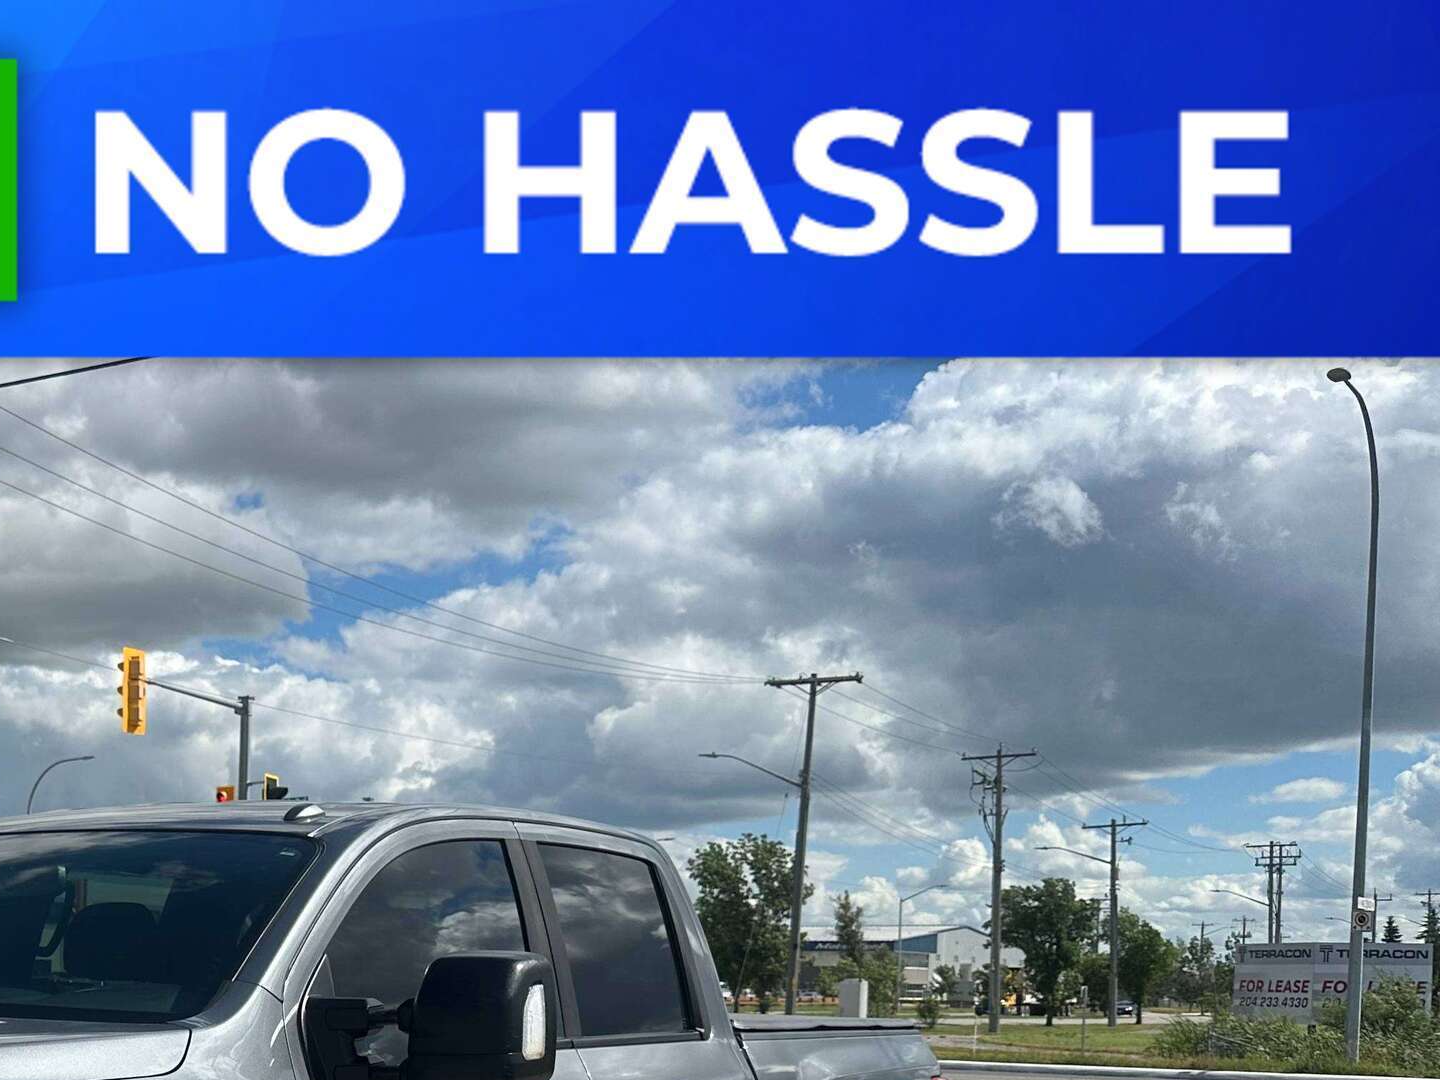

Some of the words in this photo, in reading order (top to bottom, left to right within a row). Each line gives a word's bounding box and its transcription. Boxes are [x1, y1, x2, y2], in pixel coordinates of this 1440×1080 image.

[1248, 949, 1312, 959] TERRACON
[1239, 979, 1264, 993] FOR
[1268, 980, 1310, 993] LEASE
